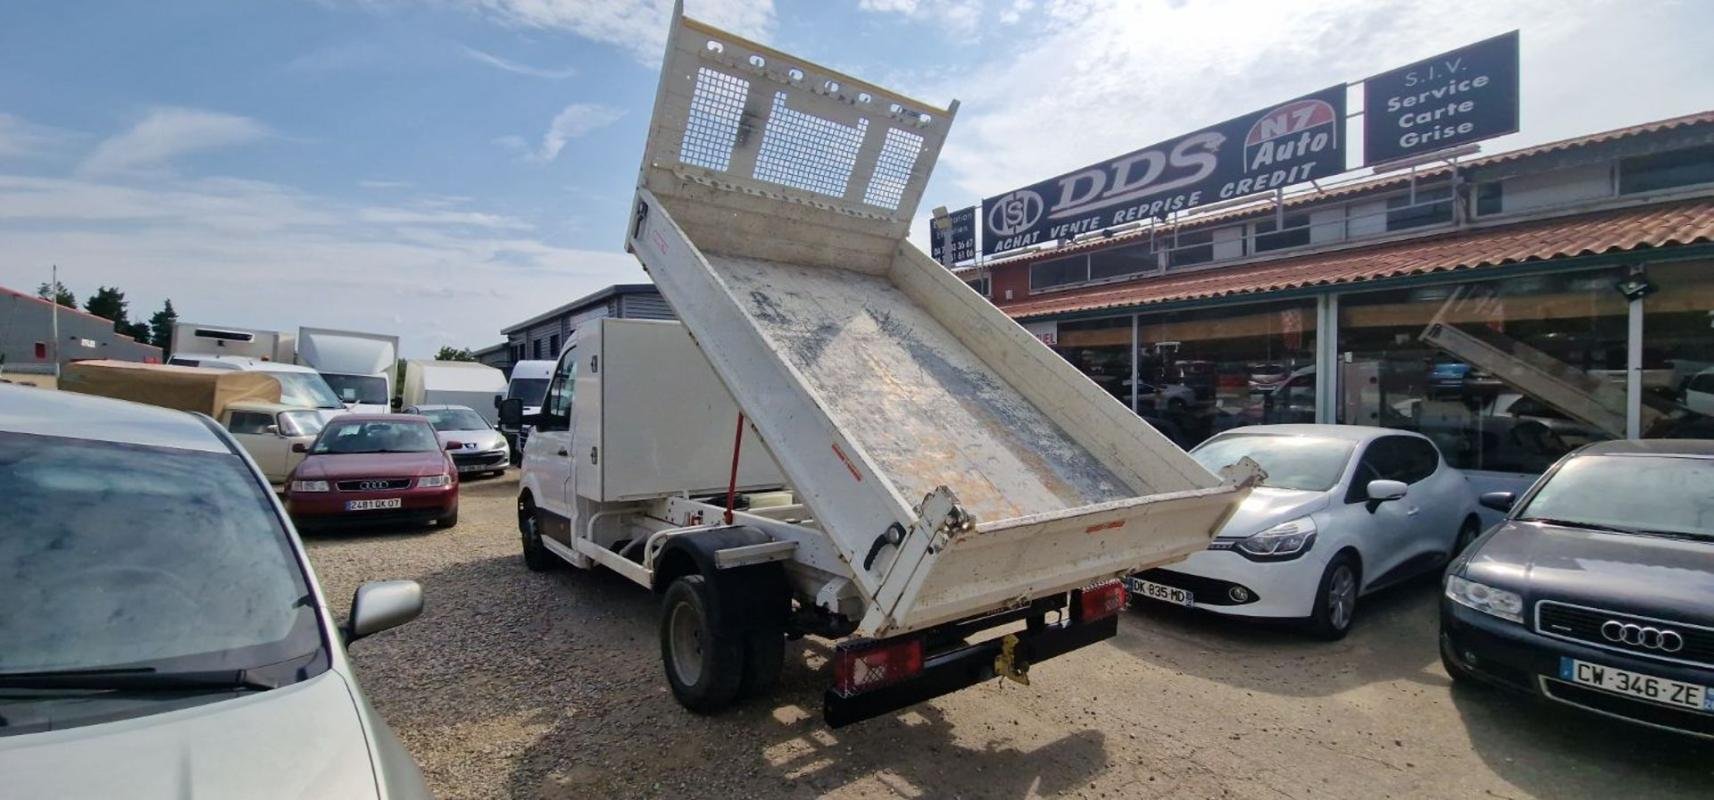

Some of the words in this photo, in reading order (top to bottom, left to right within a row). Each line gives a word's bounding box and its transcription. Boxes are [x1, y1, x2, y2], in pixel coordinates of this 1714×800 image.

[1387, 75, 1490, 113] Service
[1260, 104, 1319, 139] N7
[1398, 101, 1475, 128] Carte
[1251, 131, 1329, 171] Auto
[1400, 122, 1474, 148] Grise
[1049, 132, 1227, 217] DDS
[994, 231, 1040, 253] ACHAT
[1050, 216, 1101, 239] VENTE
[1113, 190, 1202, 225] REPRISE
[1220, 161, 1317, 199] CREDIT
